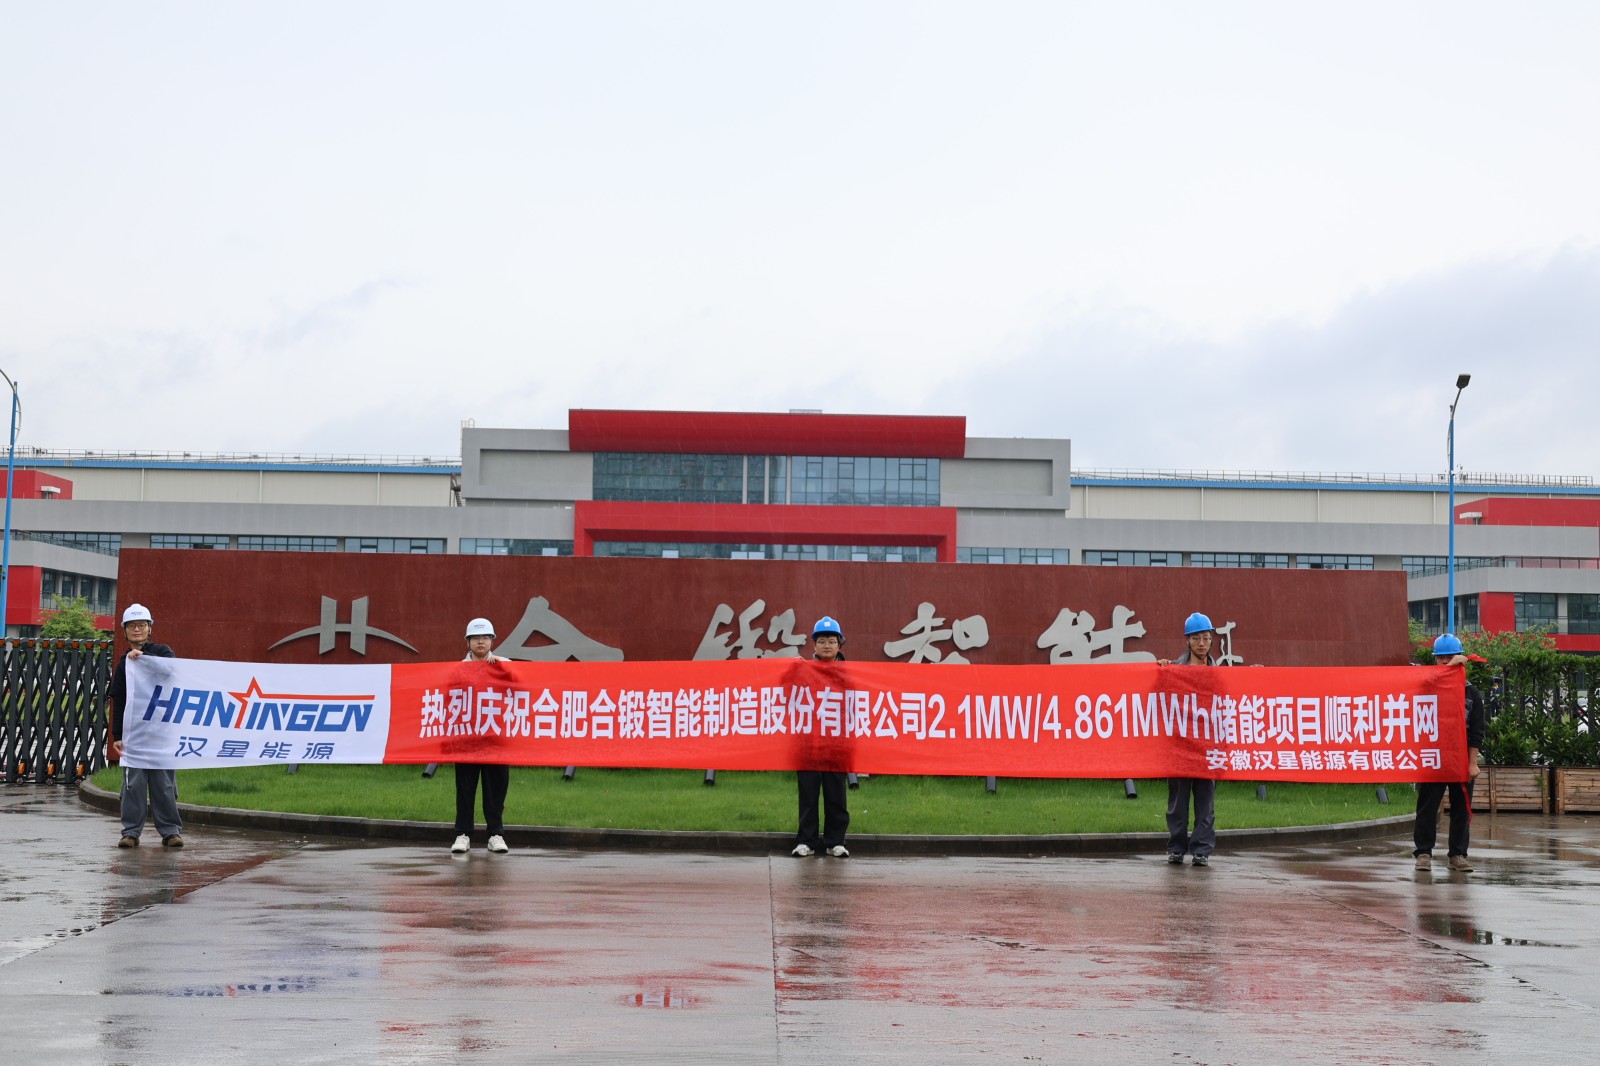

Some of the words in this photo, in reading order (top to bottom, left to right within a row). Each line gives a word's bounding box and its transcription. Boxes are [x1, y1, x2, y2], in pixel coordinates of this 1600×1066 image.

[419, 685, 1439, 744] 热烈庆祝合肥合锻智能制造股份有限公司2.1MW/4.861MWh储能项目顺利并网
[174, 736, 335, 760] 汉星能源
[1206, 748, 1441, 771] 安徽汉星能源有限公司
